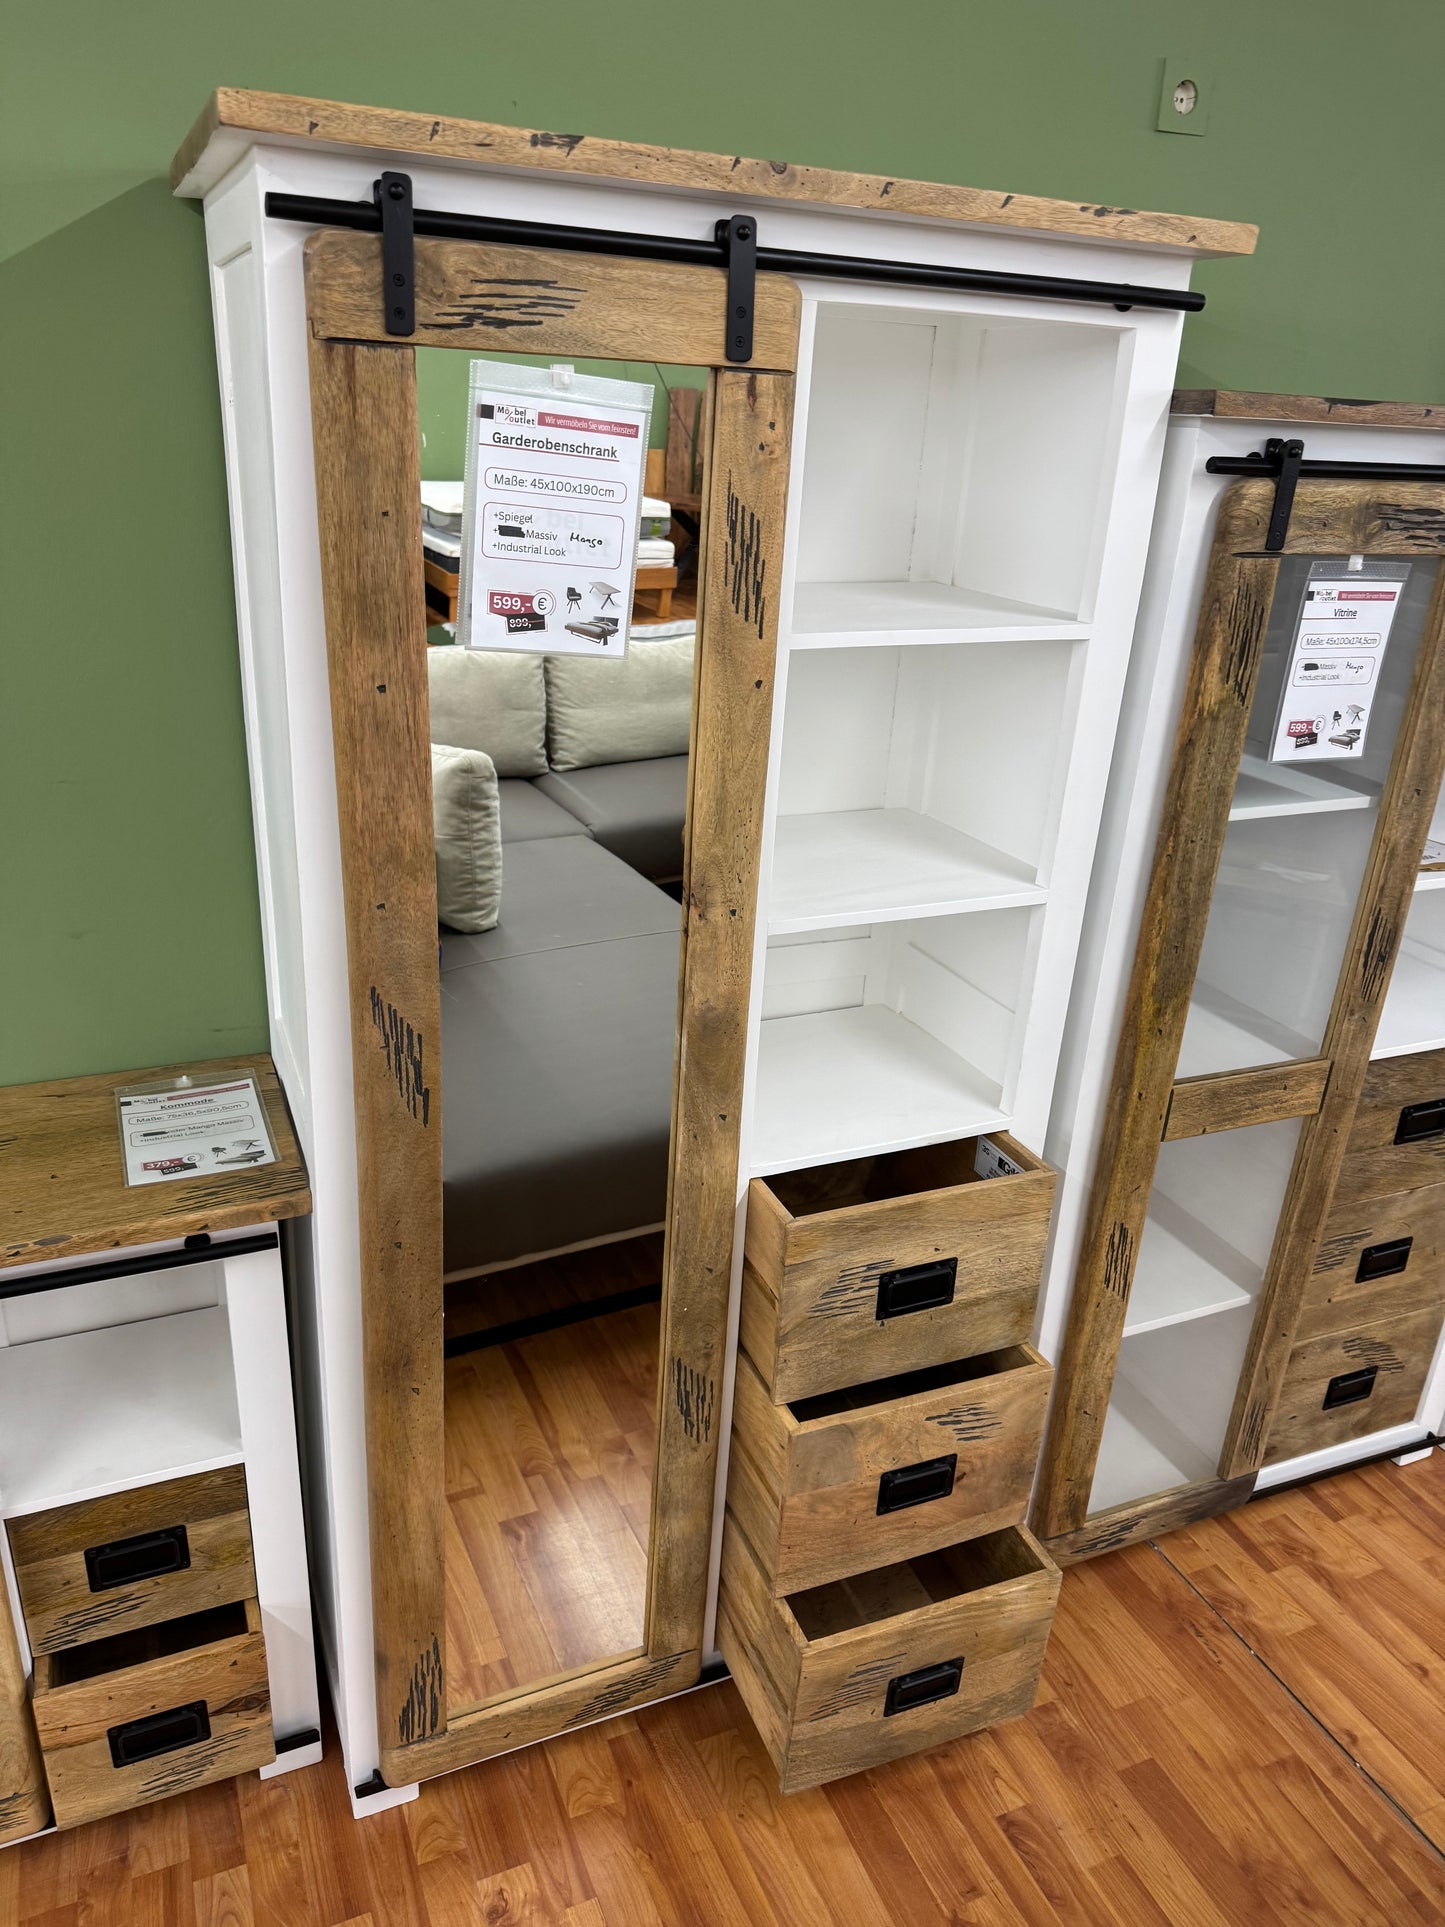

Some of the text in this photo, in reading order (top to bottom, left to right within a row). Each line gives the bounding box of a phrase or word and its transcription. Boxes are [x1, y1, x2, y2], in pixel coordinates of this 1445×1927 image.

[508, 416, 535, 426] outlet
[544, 415, 636, 436] Wir vermöbeln Sie vom feinsten!
[492, 431, 618, 459] Garderobenschrank
[493, 473, 615, 498] Maße: 45x100x190cm
[493, 511, 533, 525] +Spiegel
[569, 532, 603, 549] Mango
[492, 541, 542, 555] +Industrial
[544, 546, 566, 557] Look
[1333, 607, 1358, 617] Vitrine
[160, 1098, 214, 1110] Kommode
